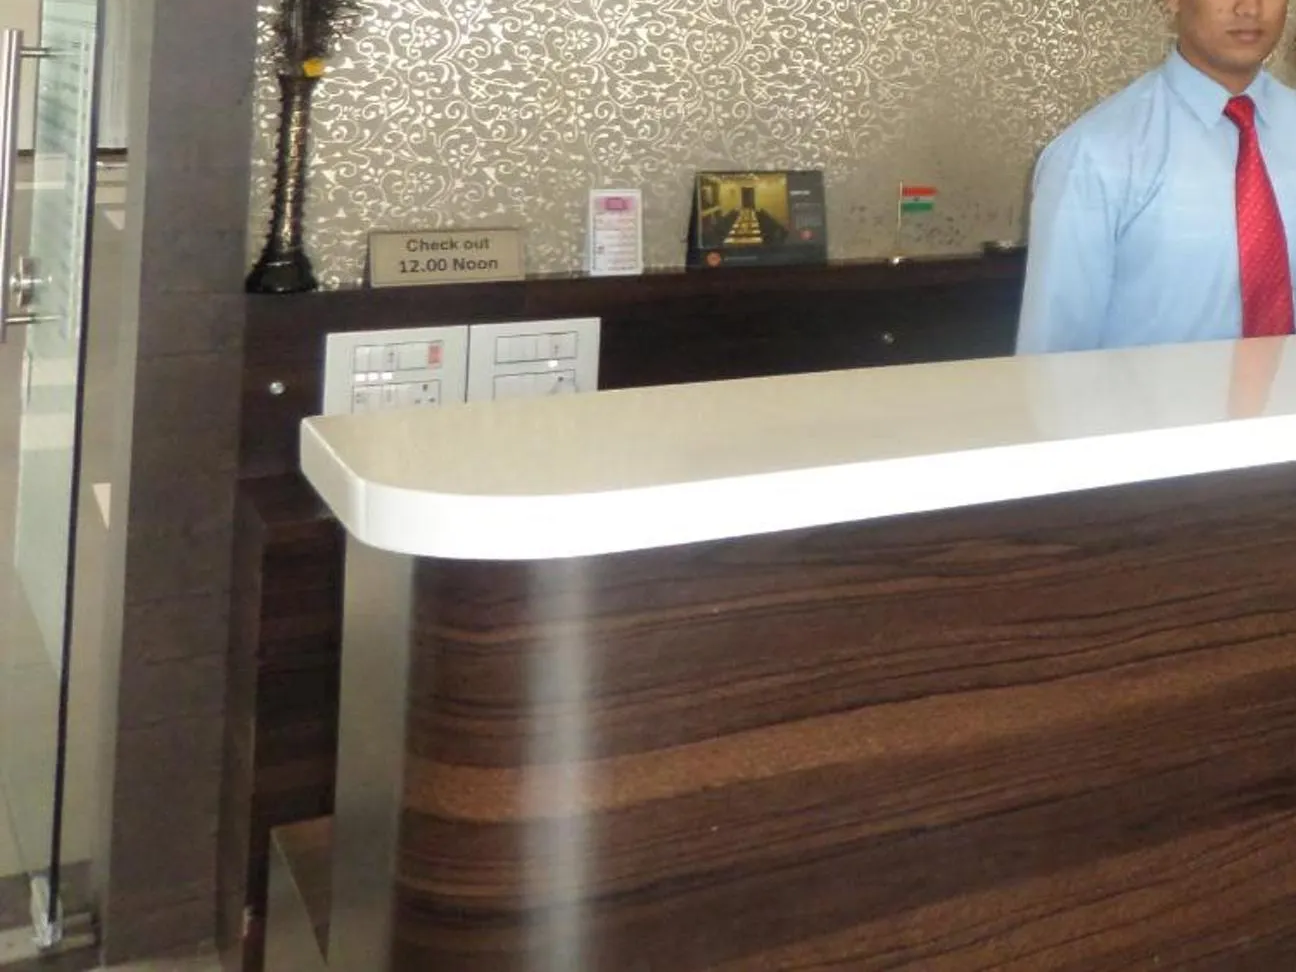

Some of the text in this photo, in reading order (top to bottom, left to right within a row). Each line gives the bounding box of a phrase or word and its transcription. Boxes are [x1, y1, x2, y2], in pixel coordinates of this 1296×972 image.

[405, 236, 491, 253] Check out
[399, 257, 499, 273] 12.00 Noon
